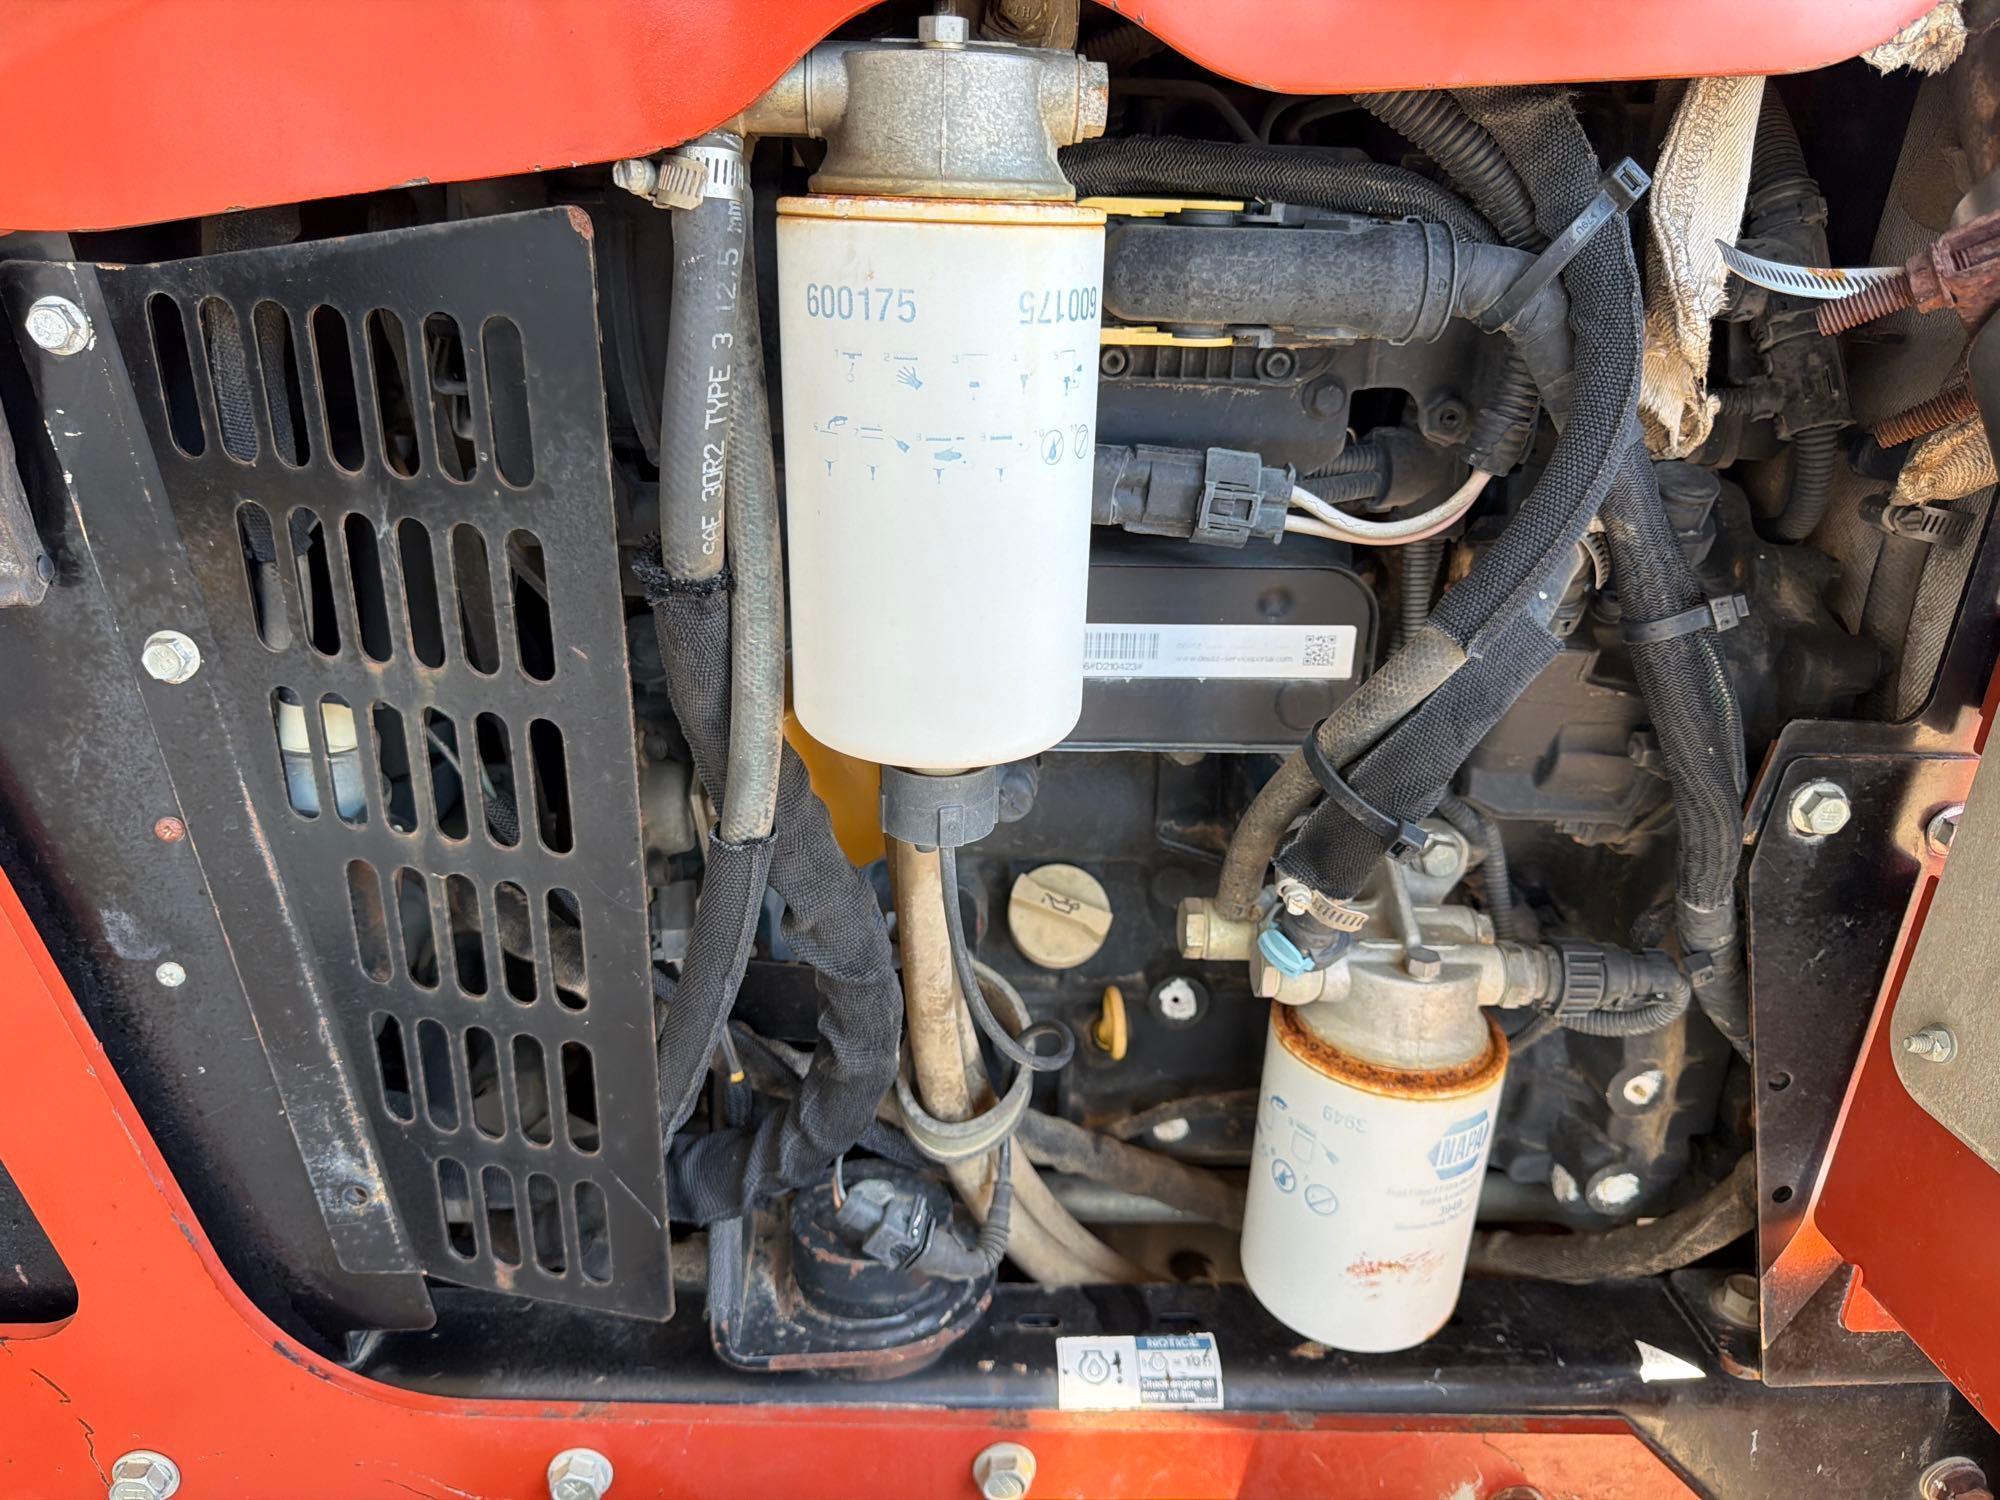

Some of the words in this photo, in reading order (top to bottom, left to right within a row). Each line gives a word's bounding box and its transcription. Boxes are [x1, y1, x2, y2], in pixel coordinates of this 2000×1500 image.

[806, 282, 917, 323] 600175
[1018, 285, 1098, 325] 600175
[712, 331, 734, 350] 3
[704, 364, 733, 431] TYPE
[702, 439, 726, 503] 30R2
[702, 511, 722, 556] SAE
[1322, 1104, 1368, 1134] 3949
[1438, 1120, 1490, 1166] NAPA
[1146, 1336, 1199, 1348] NOTICE
